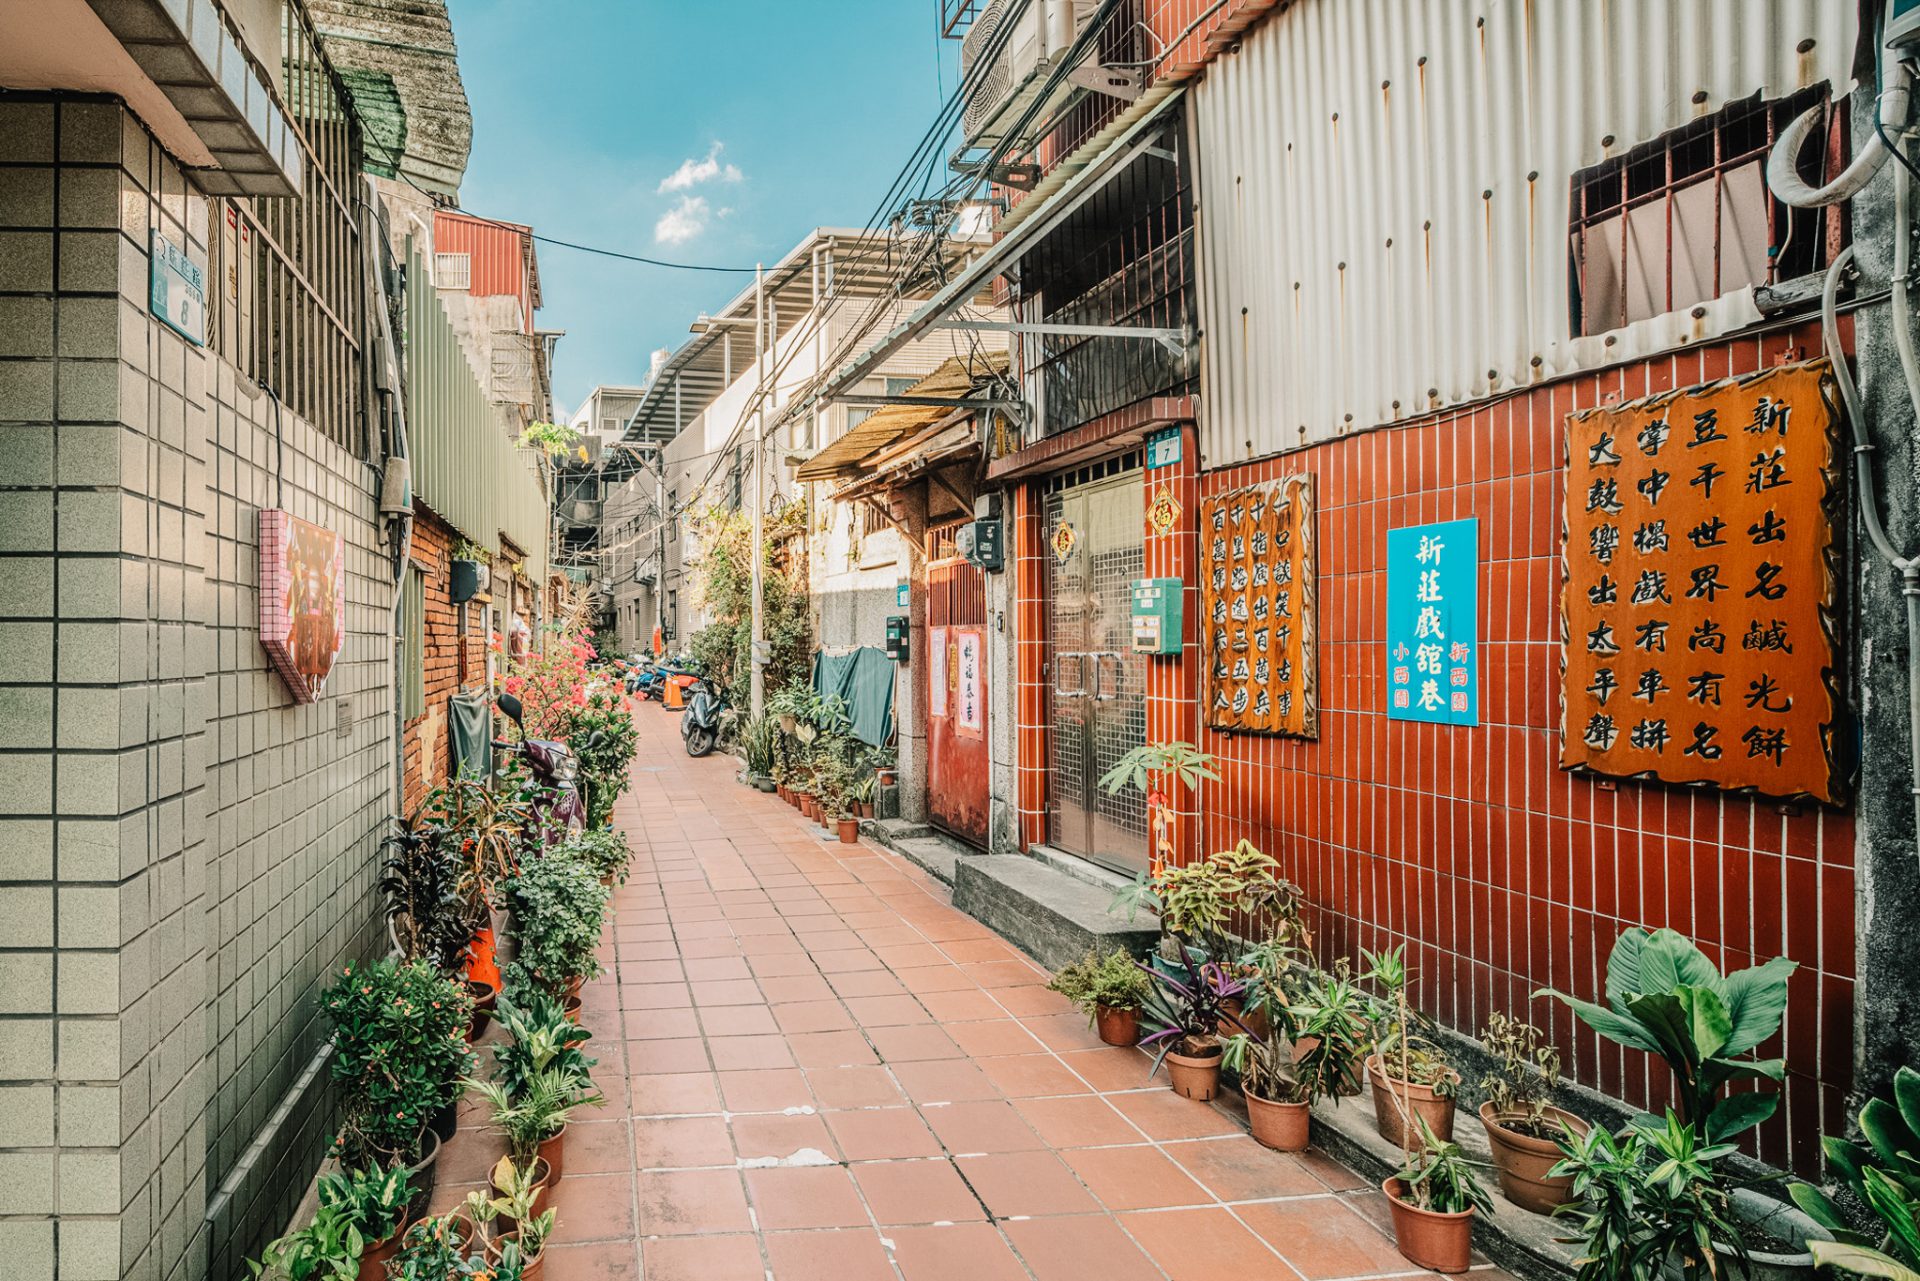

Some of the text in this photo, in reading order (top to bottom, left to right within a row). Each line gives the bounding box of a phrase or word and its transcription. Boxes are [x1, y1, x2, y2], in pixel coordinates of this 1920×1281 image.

[181, 299, 188, 326] 8
[1164, 447, 1170, 461] 7
[1583, 431, 1624, 750] 大鼓響出太平聲
[1683, 408, 1729, 760] 豆干世界尚有名
[1393, 642, 1410, 709] 小西園
[1448, 641, 1470, 713] 新西園
